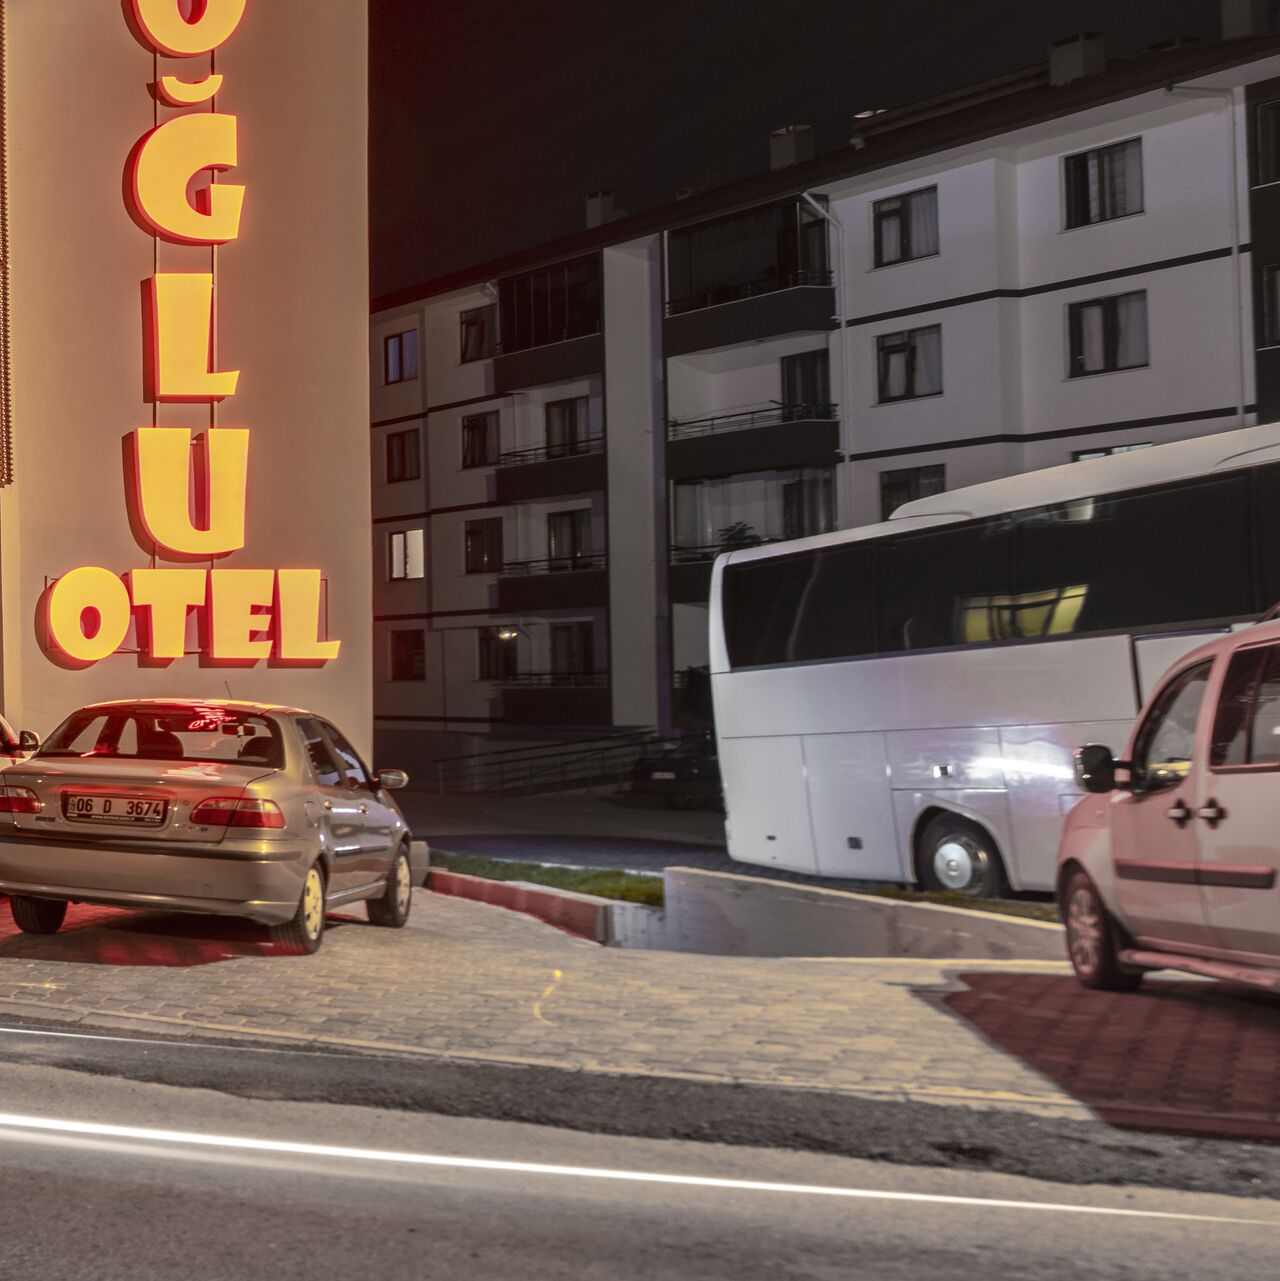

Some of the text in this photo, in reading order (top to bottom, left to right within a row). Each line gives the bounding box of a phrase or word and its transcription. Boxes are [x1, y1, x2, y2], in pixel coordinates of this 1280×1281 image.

[49, 566, 342, 662] OTEL
[76, 799, 162, 817] 06 D 3674
